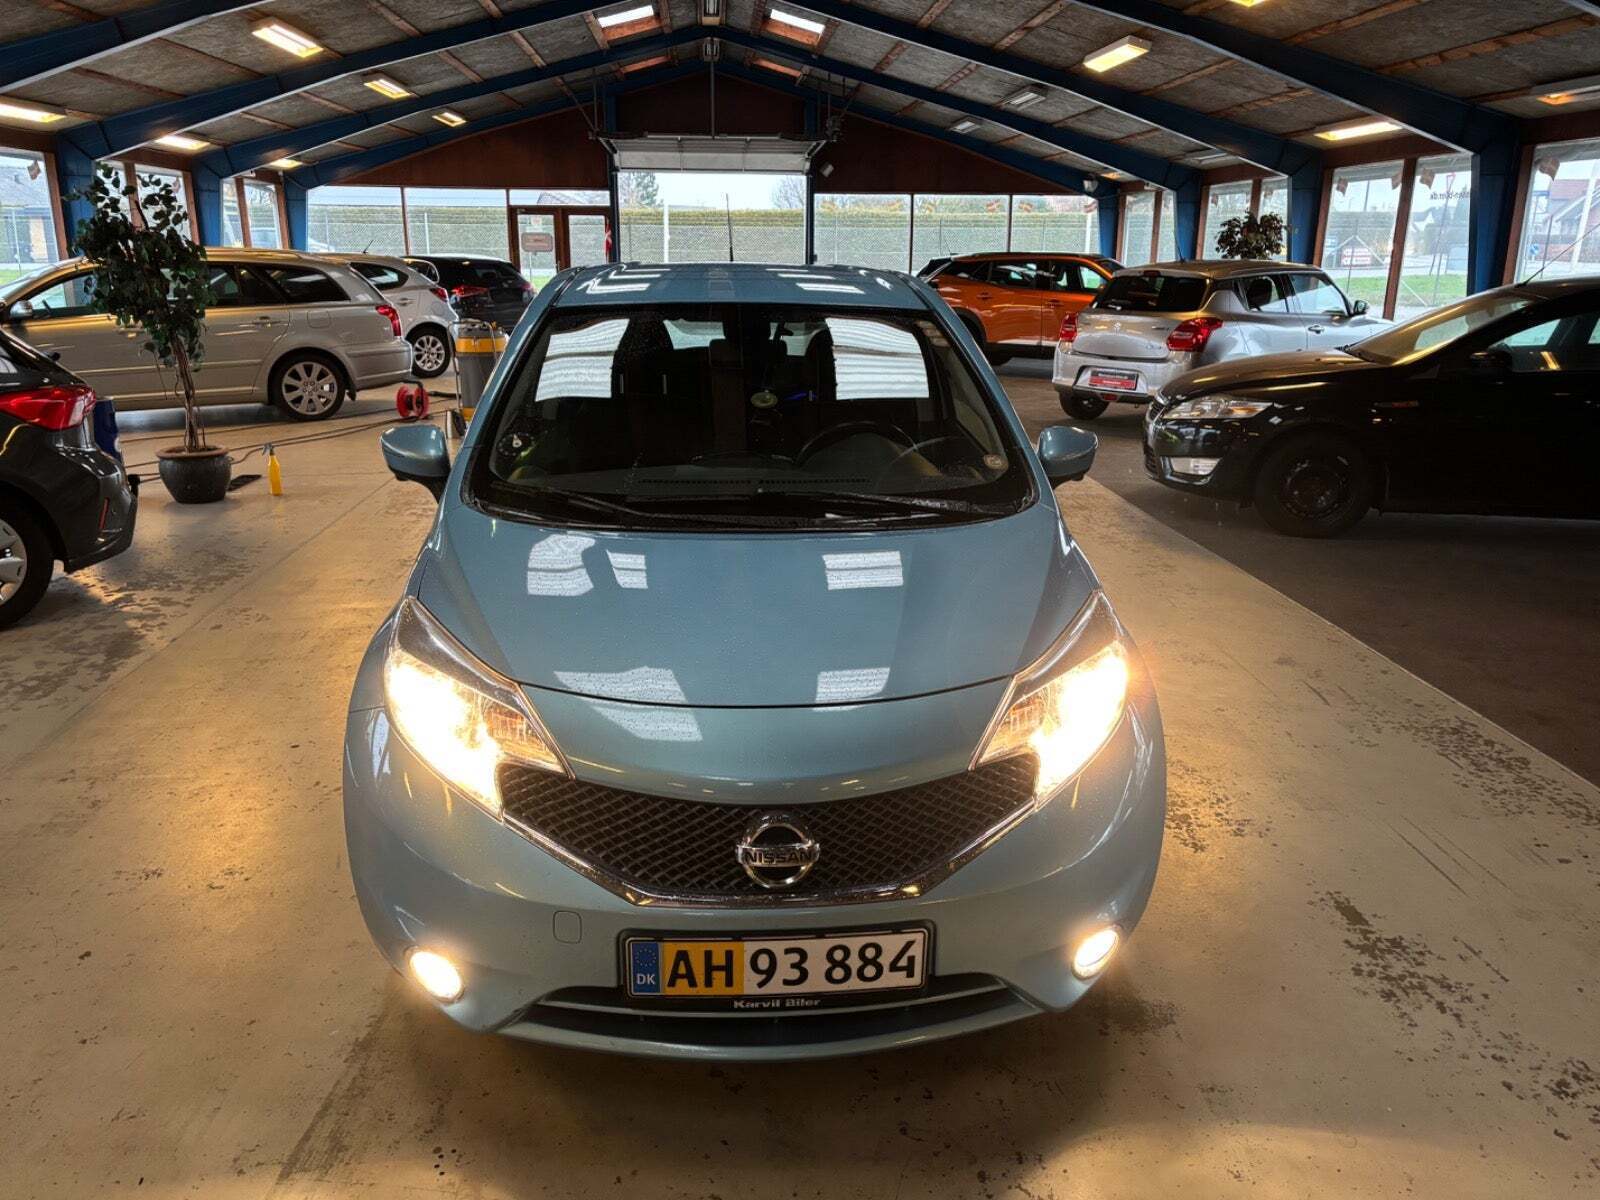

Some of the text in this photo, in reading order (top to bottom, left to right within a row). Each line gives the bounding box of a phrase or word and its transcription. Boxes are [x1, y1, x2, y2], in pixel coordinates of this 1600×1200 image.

[743, 849, 813, 865] NISSAN
[666, 940, 916, 990] AH 93 884
[636, 973, 656, 985] DK
[733, 998, 781, 1009] Karvil
